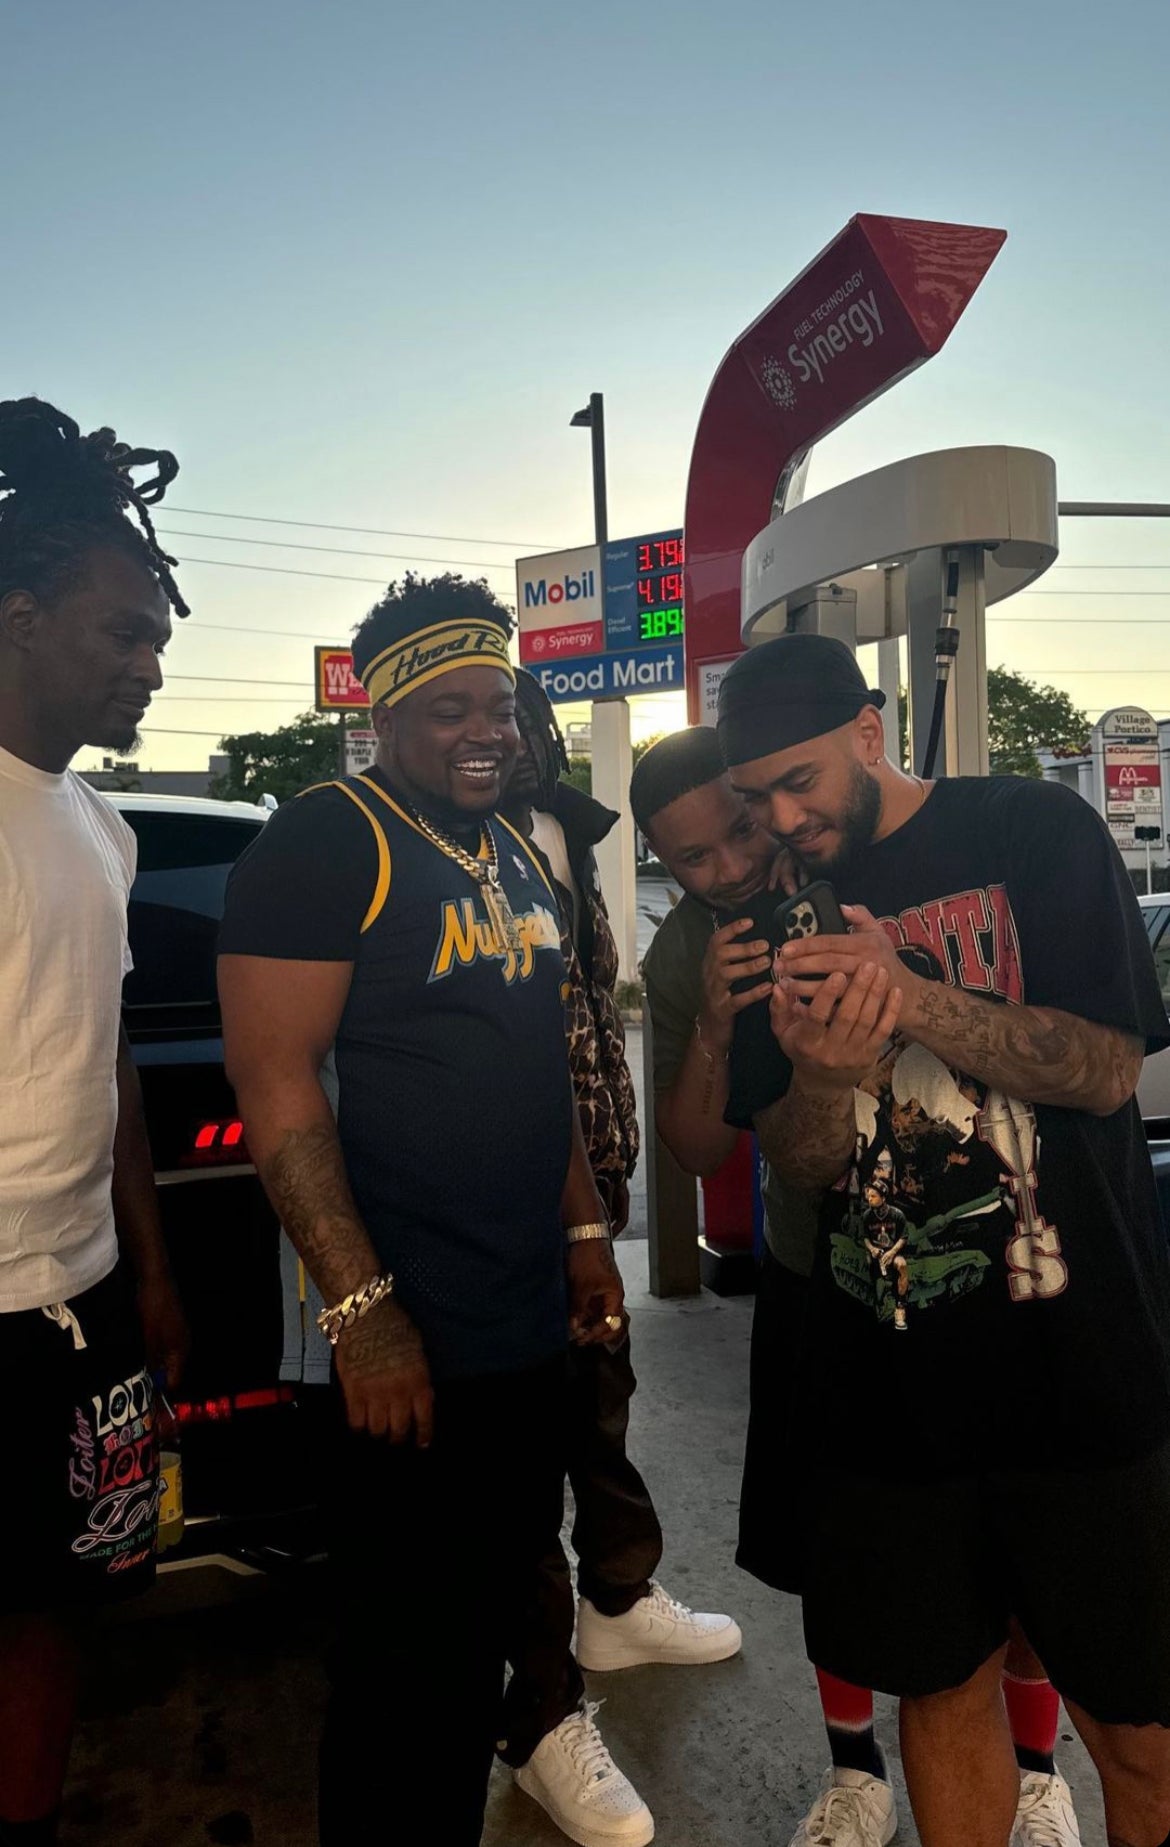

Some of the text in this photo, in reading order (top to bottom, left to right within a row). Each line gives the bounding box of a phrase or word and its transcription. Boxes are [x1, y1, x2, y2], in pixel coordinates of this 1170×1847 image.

[793, 269, 865, 341] FUEL TECHNOLOGY
[788, 290, 884, 383] Synergy
[524, 570, 595, 608] Mobil
[549, 633, 594, 650] Synergy
[541, 654, 675, 694] Food Mart
[1114, 714, 1151, 726] Village
[1114, 724, 1151, 734] Portico
